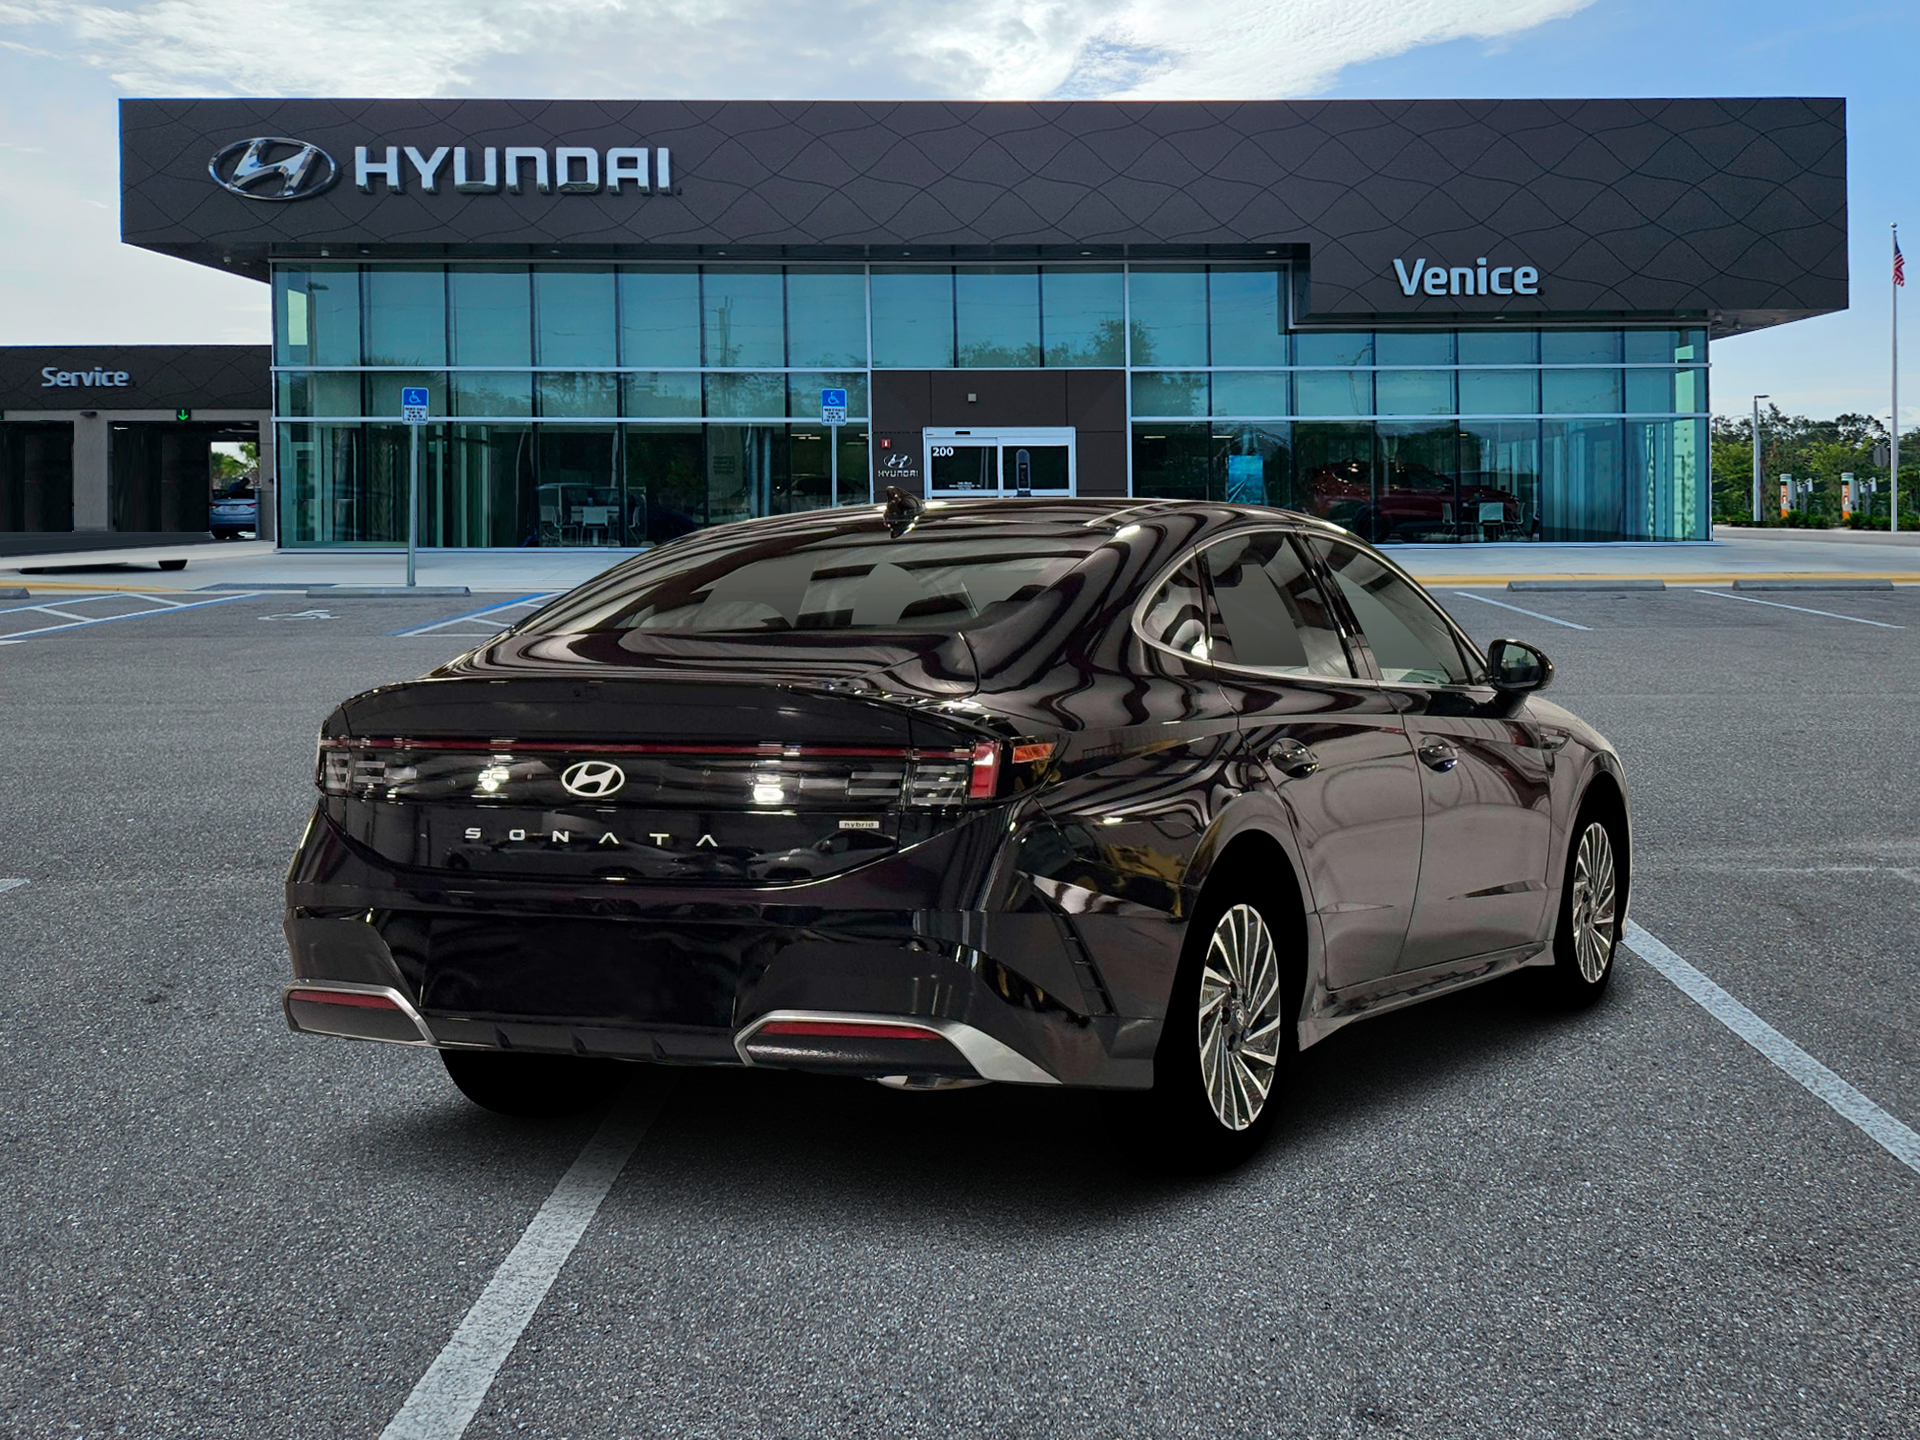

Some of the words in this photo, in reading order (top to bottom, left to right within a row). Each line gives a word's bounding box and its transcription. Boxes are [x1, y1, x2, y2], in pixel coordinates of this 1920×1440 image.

[353, 146, 672, 194] HYUNDAI
[1393, 257, 1539, 296] Venice
[41, 366, 130, 387] Service
[932, 447, 954, 457] 200
[464, 827, 719, 848] SONATA
